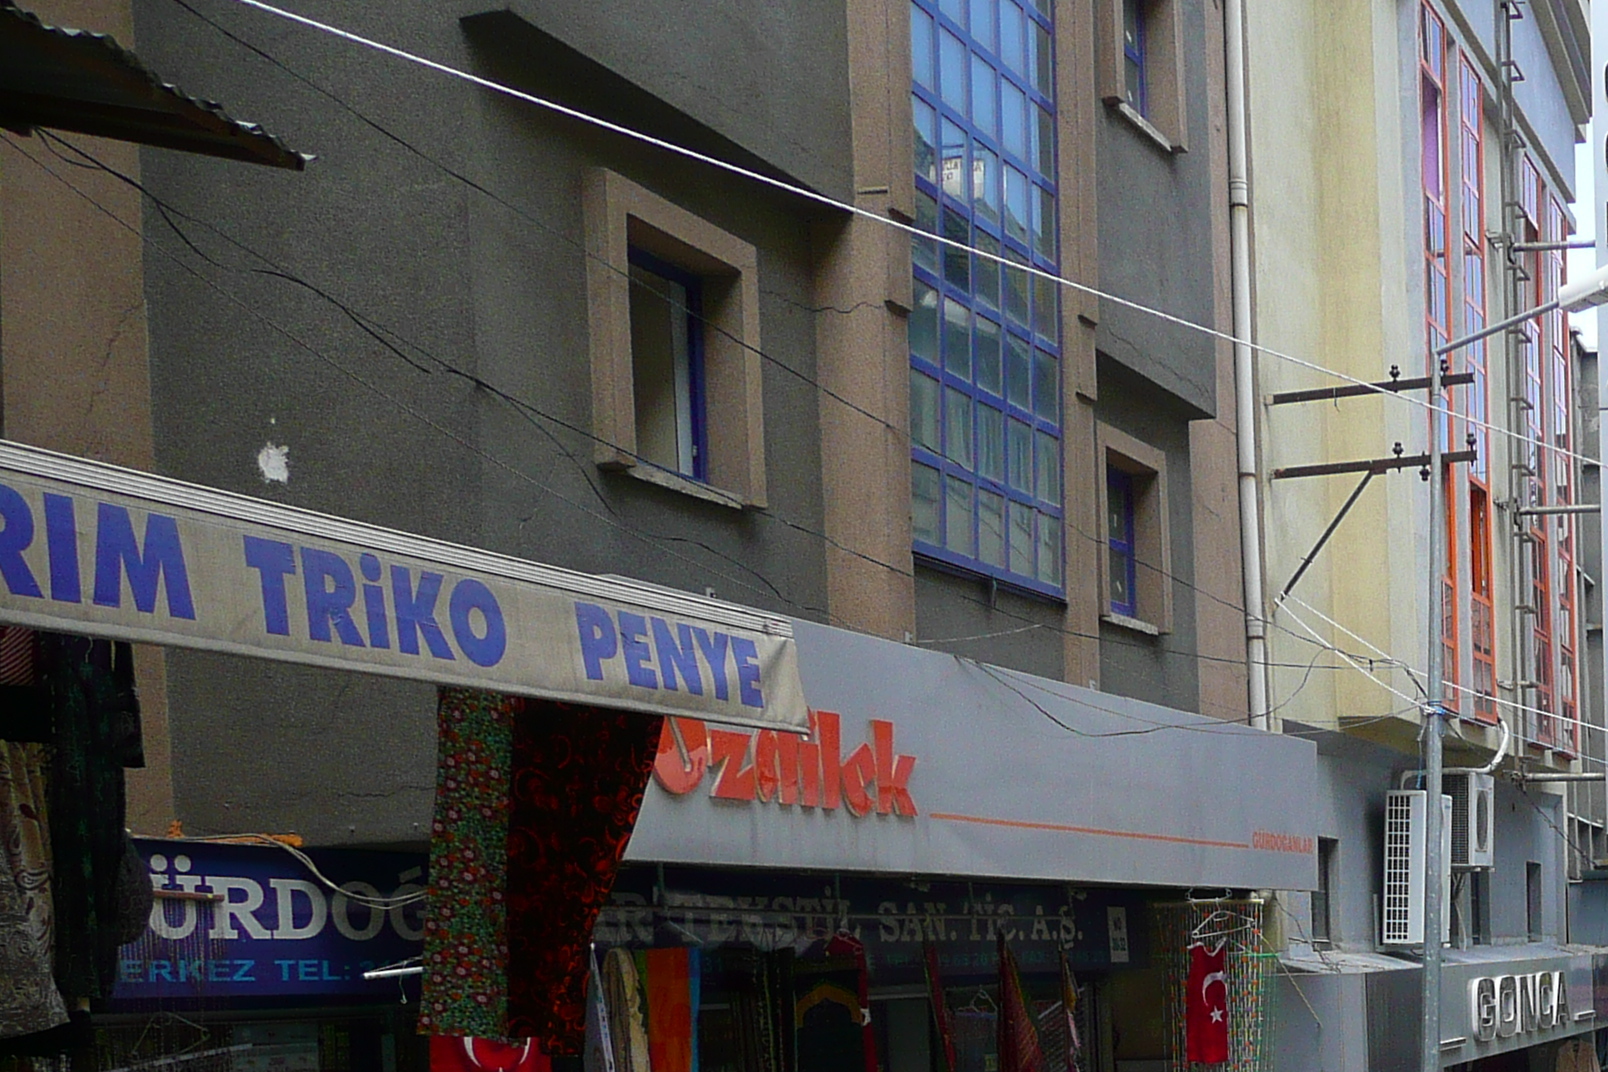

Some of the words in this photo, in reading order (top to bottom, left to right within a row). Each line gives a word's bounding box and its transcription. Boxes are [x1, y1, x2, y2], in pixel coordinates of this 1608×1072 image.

[573, 602, 765, 710] PENYE
[878, 901, 957, 943] SAN.
[274, 958, 350, 982] TEL:
[1472, 970, 1570, 1041] GONCA
